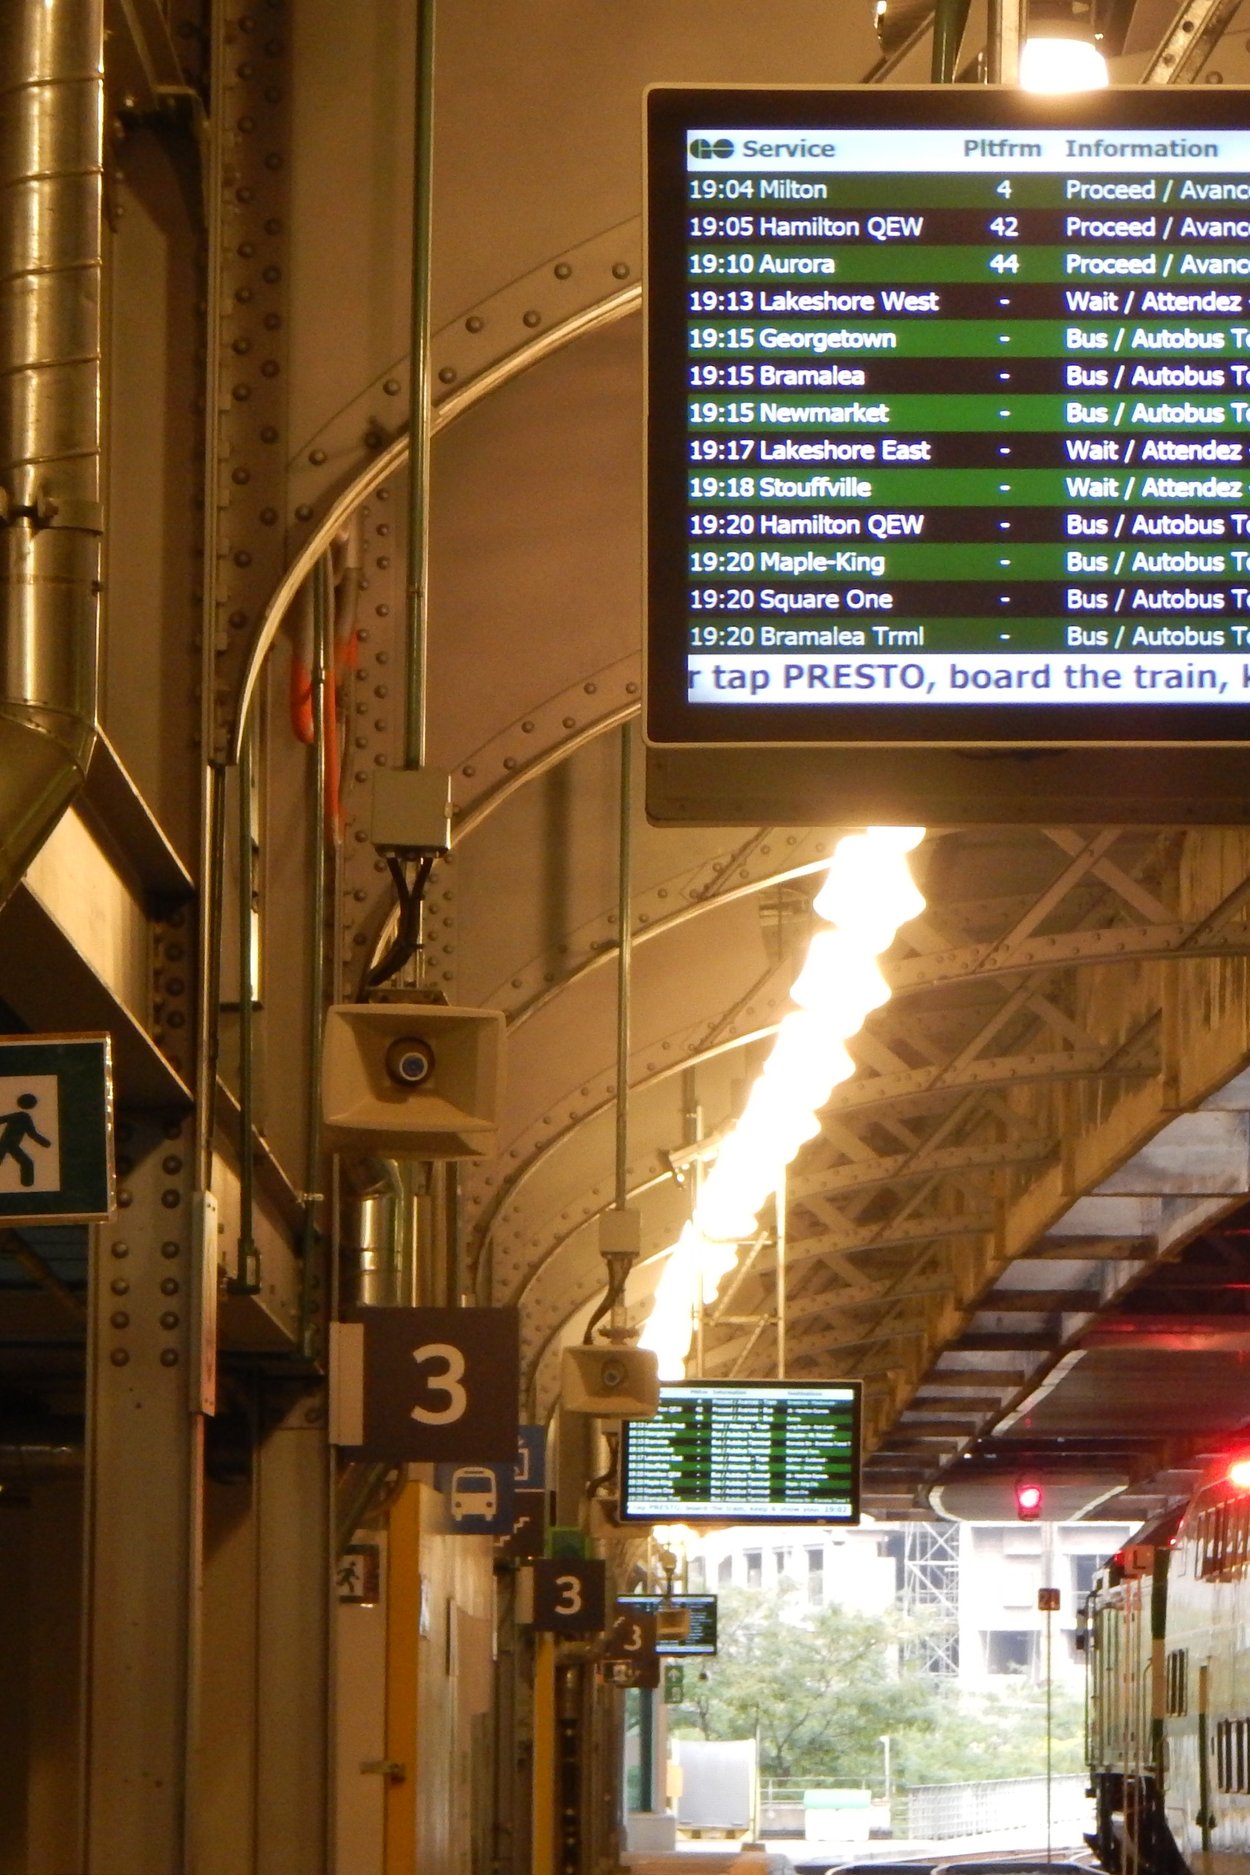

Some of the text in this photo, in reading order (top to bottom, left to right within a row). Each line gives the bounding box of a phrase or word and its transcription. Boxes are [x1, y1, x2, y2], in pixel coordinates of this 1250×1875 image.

[743, 138, 836, 158] Service
[964, 138, 1042, 157] Pltfrm
[1065, 138, 1219, 158] Information
[690, 178, 828, 199] 19:04 Milton
[996, 179, 1013, 199] 4
[1066, 179, 1156, 200] Proceed
[690, 215, 924, 241] 19:05 Hamilton QEW
[989, 216, 1019, 237] 42
[1066, 216, 1156, 237] Proceed
[690, 253, 836, 274] 19:10 Aurora
[989, 253, 1020, 274] 44
[1066, 253, 1157, 275] Proceed
[690, 290, 940, 312] 19:13 Lakeshore West
[1065, 290, 1119, 312] Wait
[1141, 290, 1243, 312] Attendez
[690, 327, 897, 353] 19:15 Georgetown
[1066, 327, 1109, 349] Bus
[1131, 327, 1226, 349] Autobus
[690, 364, 866, 386] 19:15 Bramalea
[1066, 365, 1109, 386] Bus
[1131, 364, 1226, 387] Autobus
[690, 401, 890, 423] 19:15 Newmarket
[1066, 402, 1109, 424] Bus
[1131, 401, 1226, 424] Autobus
[690, 439, 932, 461] 19:17 Lakeshore East
[1065, 439, 1120, 461] Wait
[1141, 439, 1243, 461] Attendez
[690, 476, 872, 498] 19:18 Stouffville
[1065, 477, 1120, 498] Wait
[1141, 476, 1243, 498] Attendez
[690, 513, 925, 540] 19:20 Hamilton QEW
[1067, 514, 1109, 535] Bus
[1131, 513, 1226, 535] Autobus
[691, 551, 886, 577] 19:20 Maple-King
[1067, 551, 1109, 572] Bus
[1131, 550, 1226, 572] Autobus
[691, 588, 894, 613] 19:20 Square One
[1067, 588, 1109, 610] Bus
[1132, 588, 1225, 609] Autobus
[691, 625, 924, 646] 19:20 Bramalea Trml
[1067, 625, 1109, 646] Bus
[1132, 625, 1225, 646] Autobus
[711, 664, 770, 696] tap
[784, 663, 935, 695] PRESTO,
[950, 663, 1051, 690] board
[1064, 663, 1122, 689] the
[1133, 662, 1228, 695] train,
[410, 1343, 468, 1426] 3
[1133, 1550, 1147, 1570] L
[554, 1576, 582, 1616] 3
[623, 1624, 642, 1651] 3
